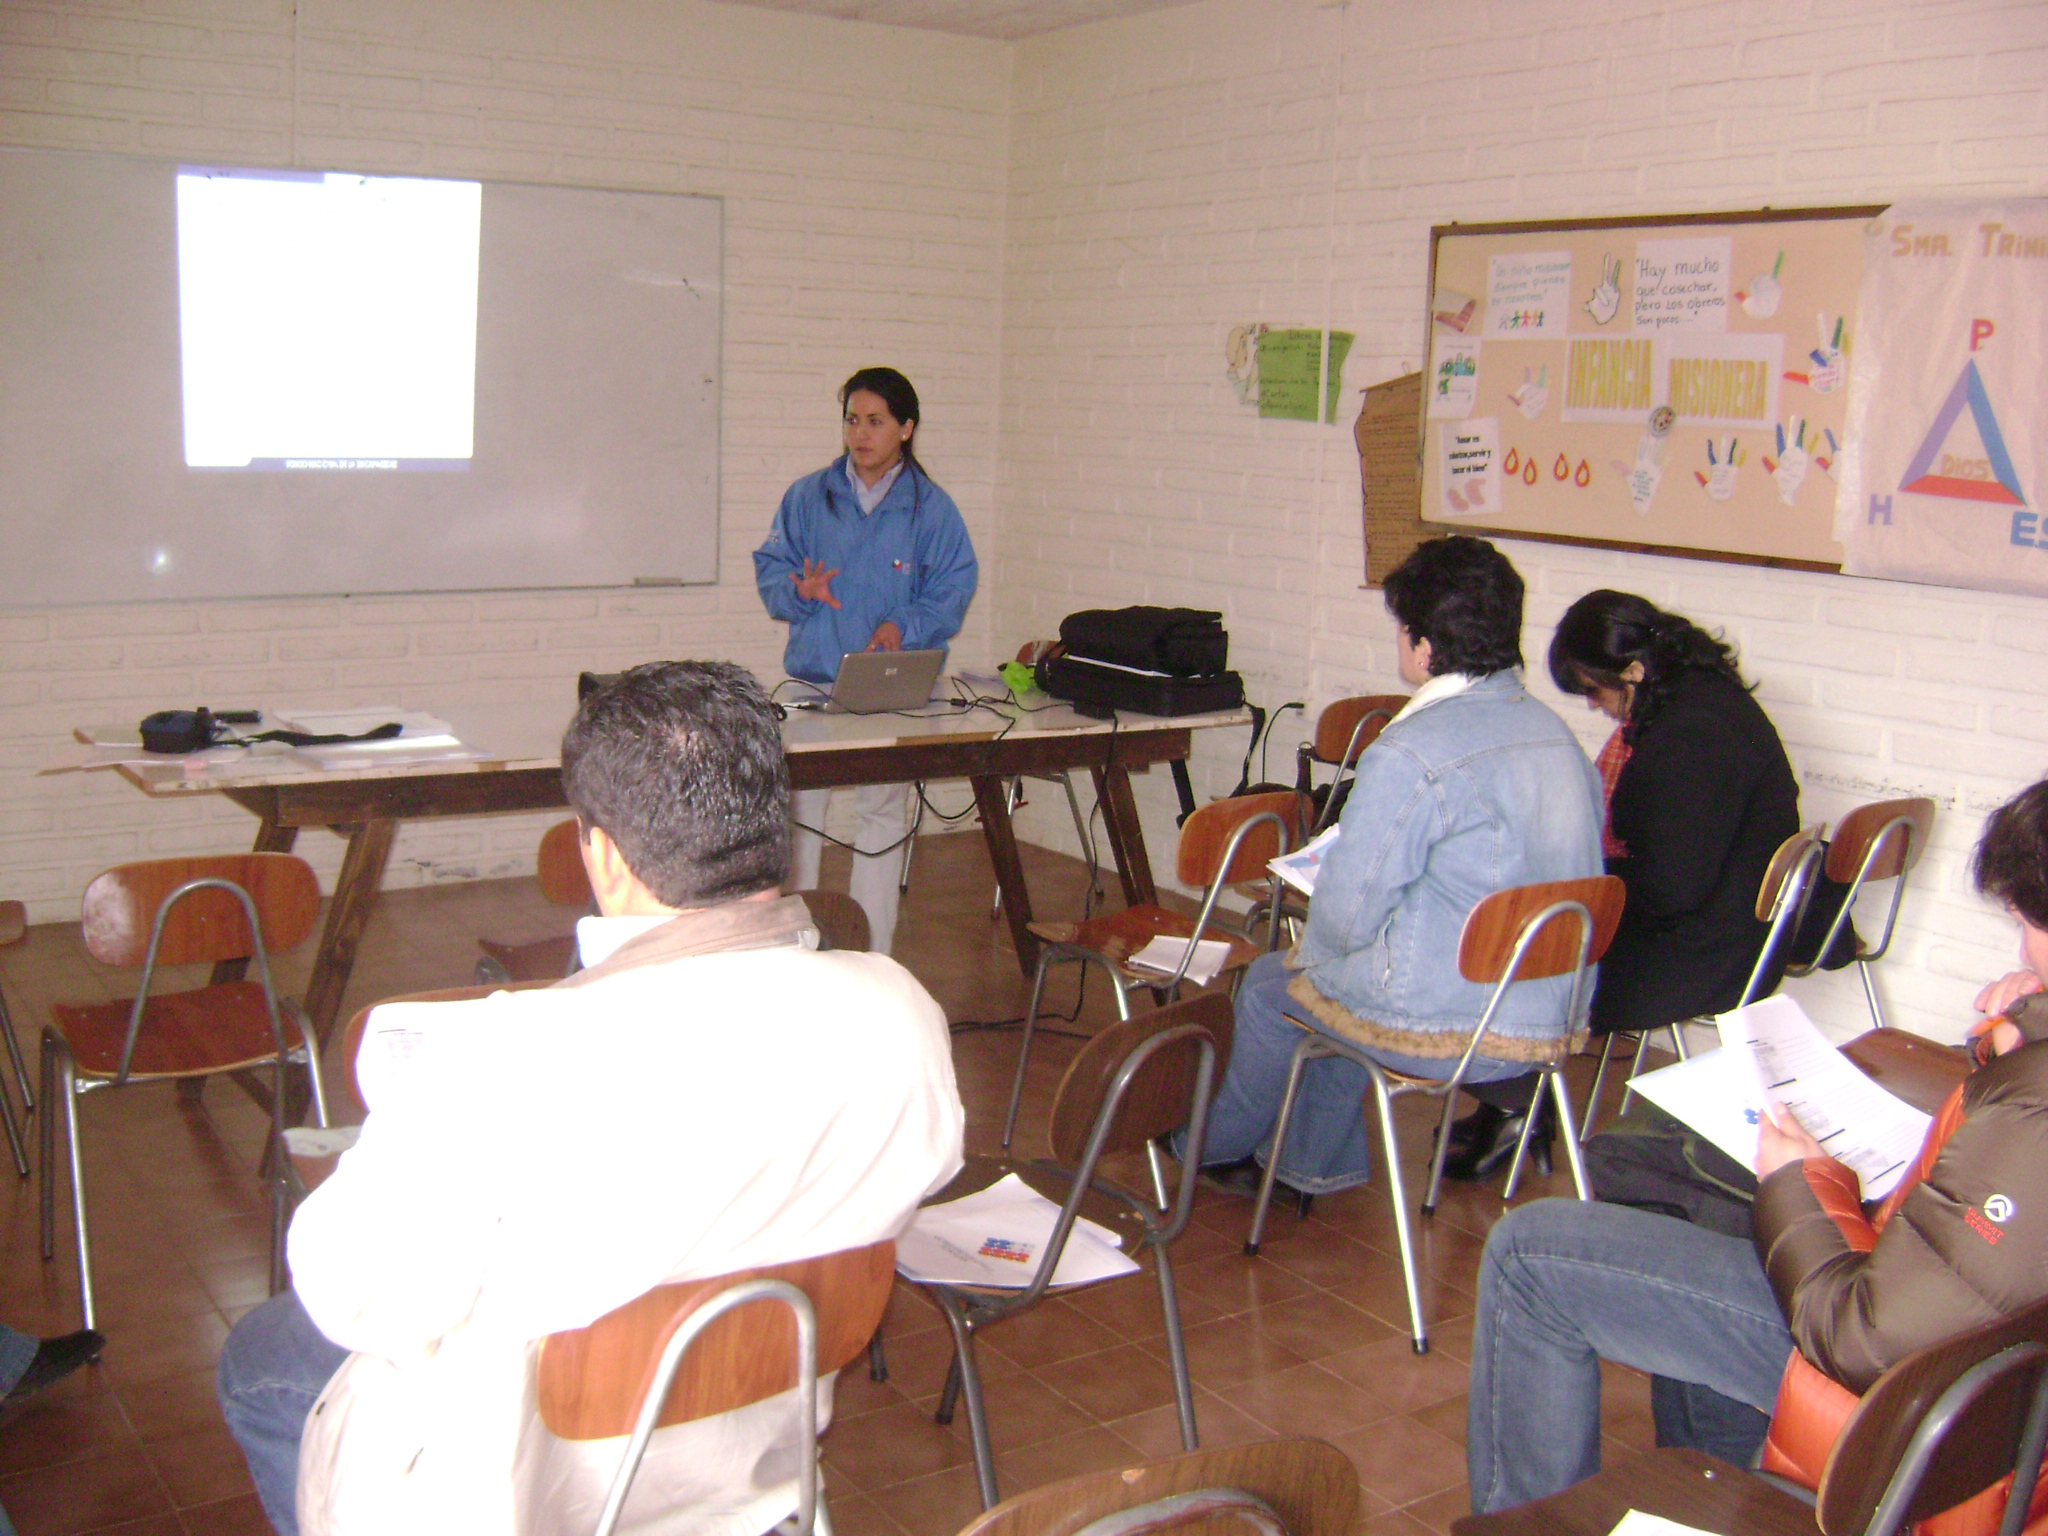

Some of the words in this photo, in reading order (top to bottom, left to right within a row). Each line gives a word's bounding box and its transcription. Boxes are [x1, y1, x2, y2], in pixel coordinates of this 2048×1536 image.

[1675, 257, 1719, 275] mucho
[1636, 286, 1656, 303] que
[1635, 301, 1661, 315] pero
[1565, 339, 1653, 410] INFANCIA
[1667, 357, 1768, 420] MISIONERA
[1964, 1214, 1998, 1246] SERIES
[1966, 1206, 2005, 1239] SUMMIT
